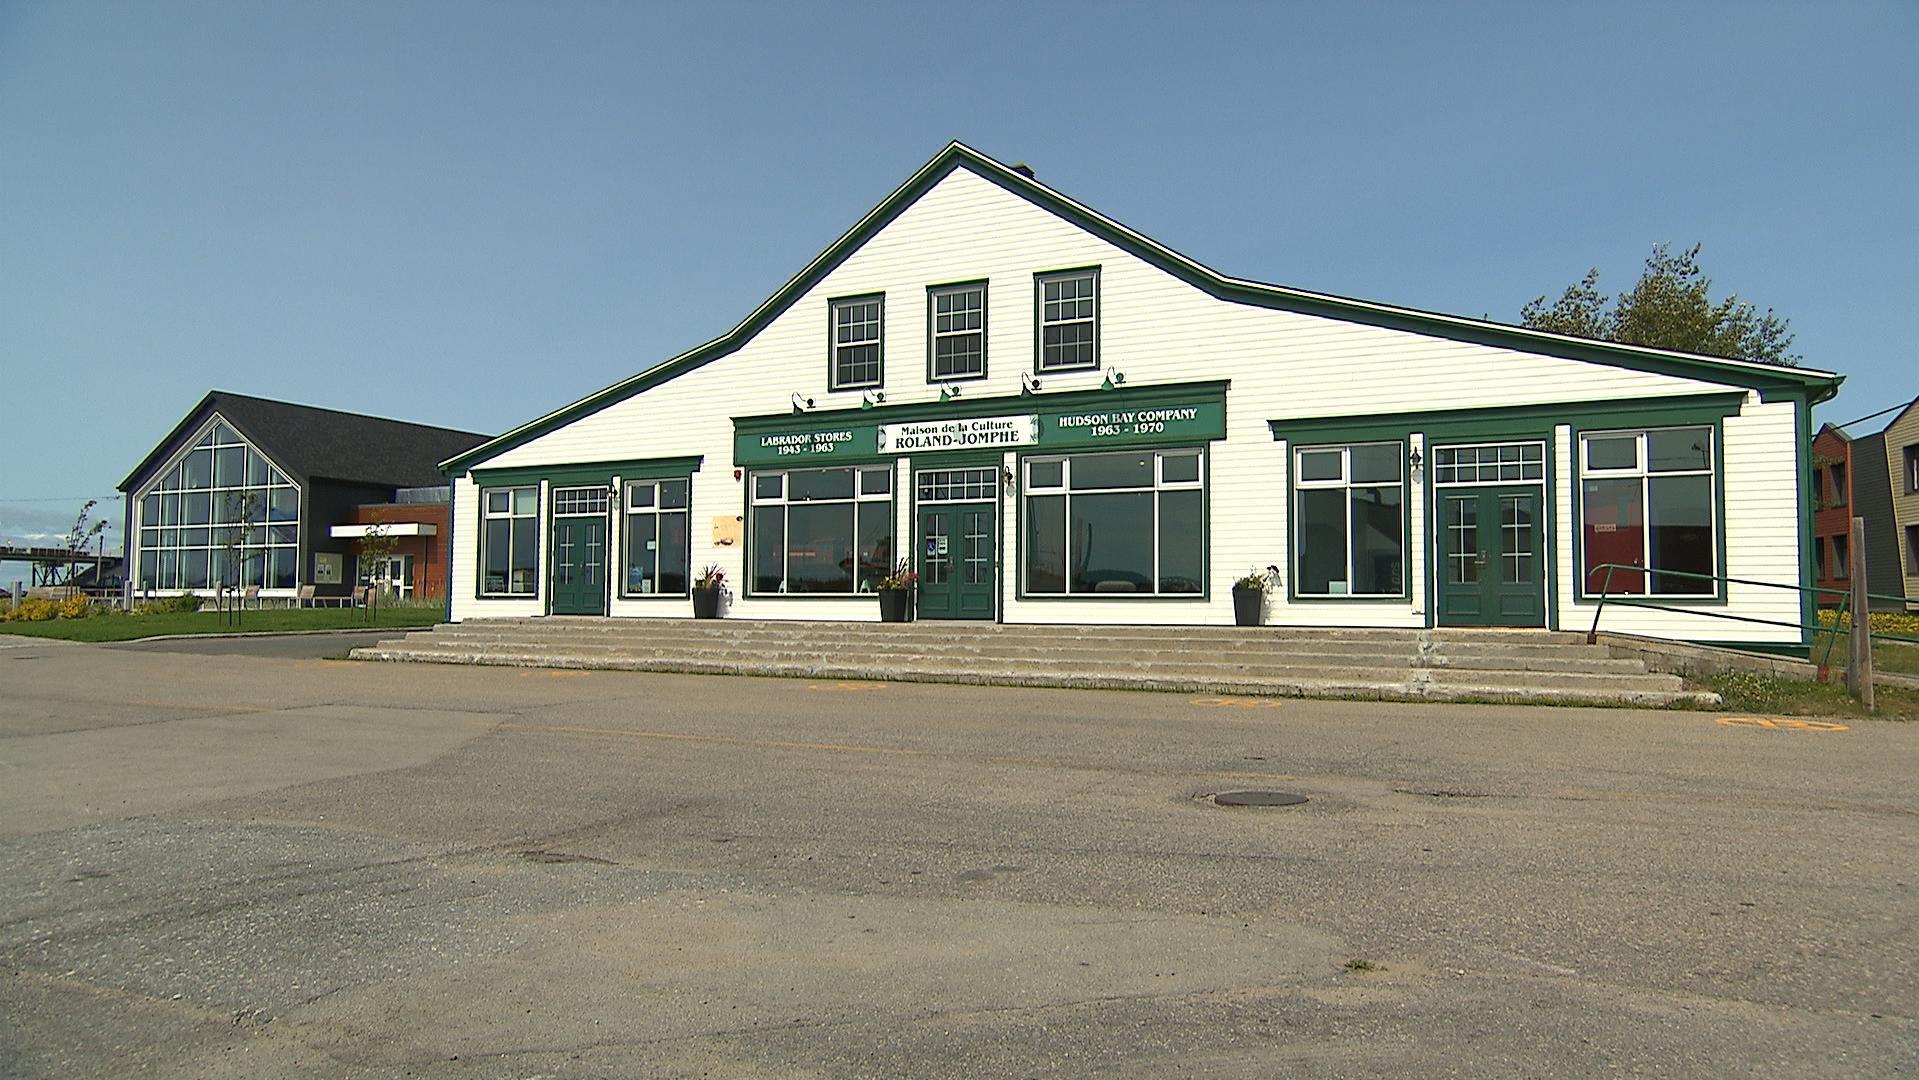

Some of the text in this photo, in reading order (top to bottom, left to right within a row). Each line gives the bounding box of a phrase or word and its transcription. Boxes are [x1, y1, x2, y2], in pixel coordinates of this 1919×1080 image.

[1059, 408, 1198, 428] HUDSON BAY COMPANY
[901, 420, 1014, 436] Maison de la Culture
[1090, 424, 1121, 436] 1963
[1133, 422, 1164, 434] 1970
[761, 431, 852, 446] LABRADOR STORES
[895, 430, 1020, 449] ROLAND-JOMPHE
[811, 443, 834, 453] 1963
